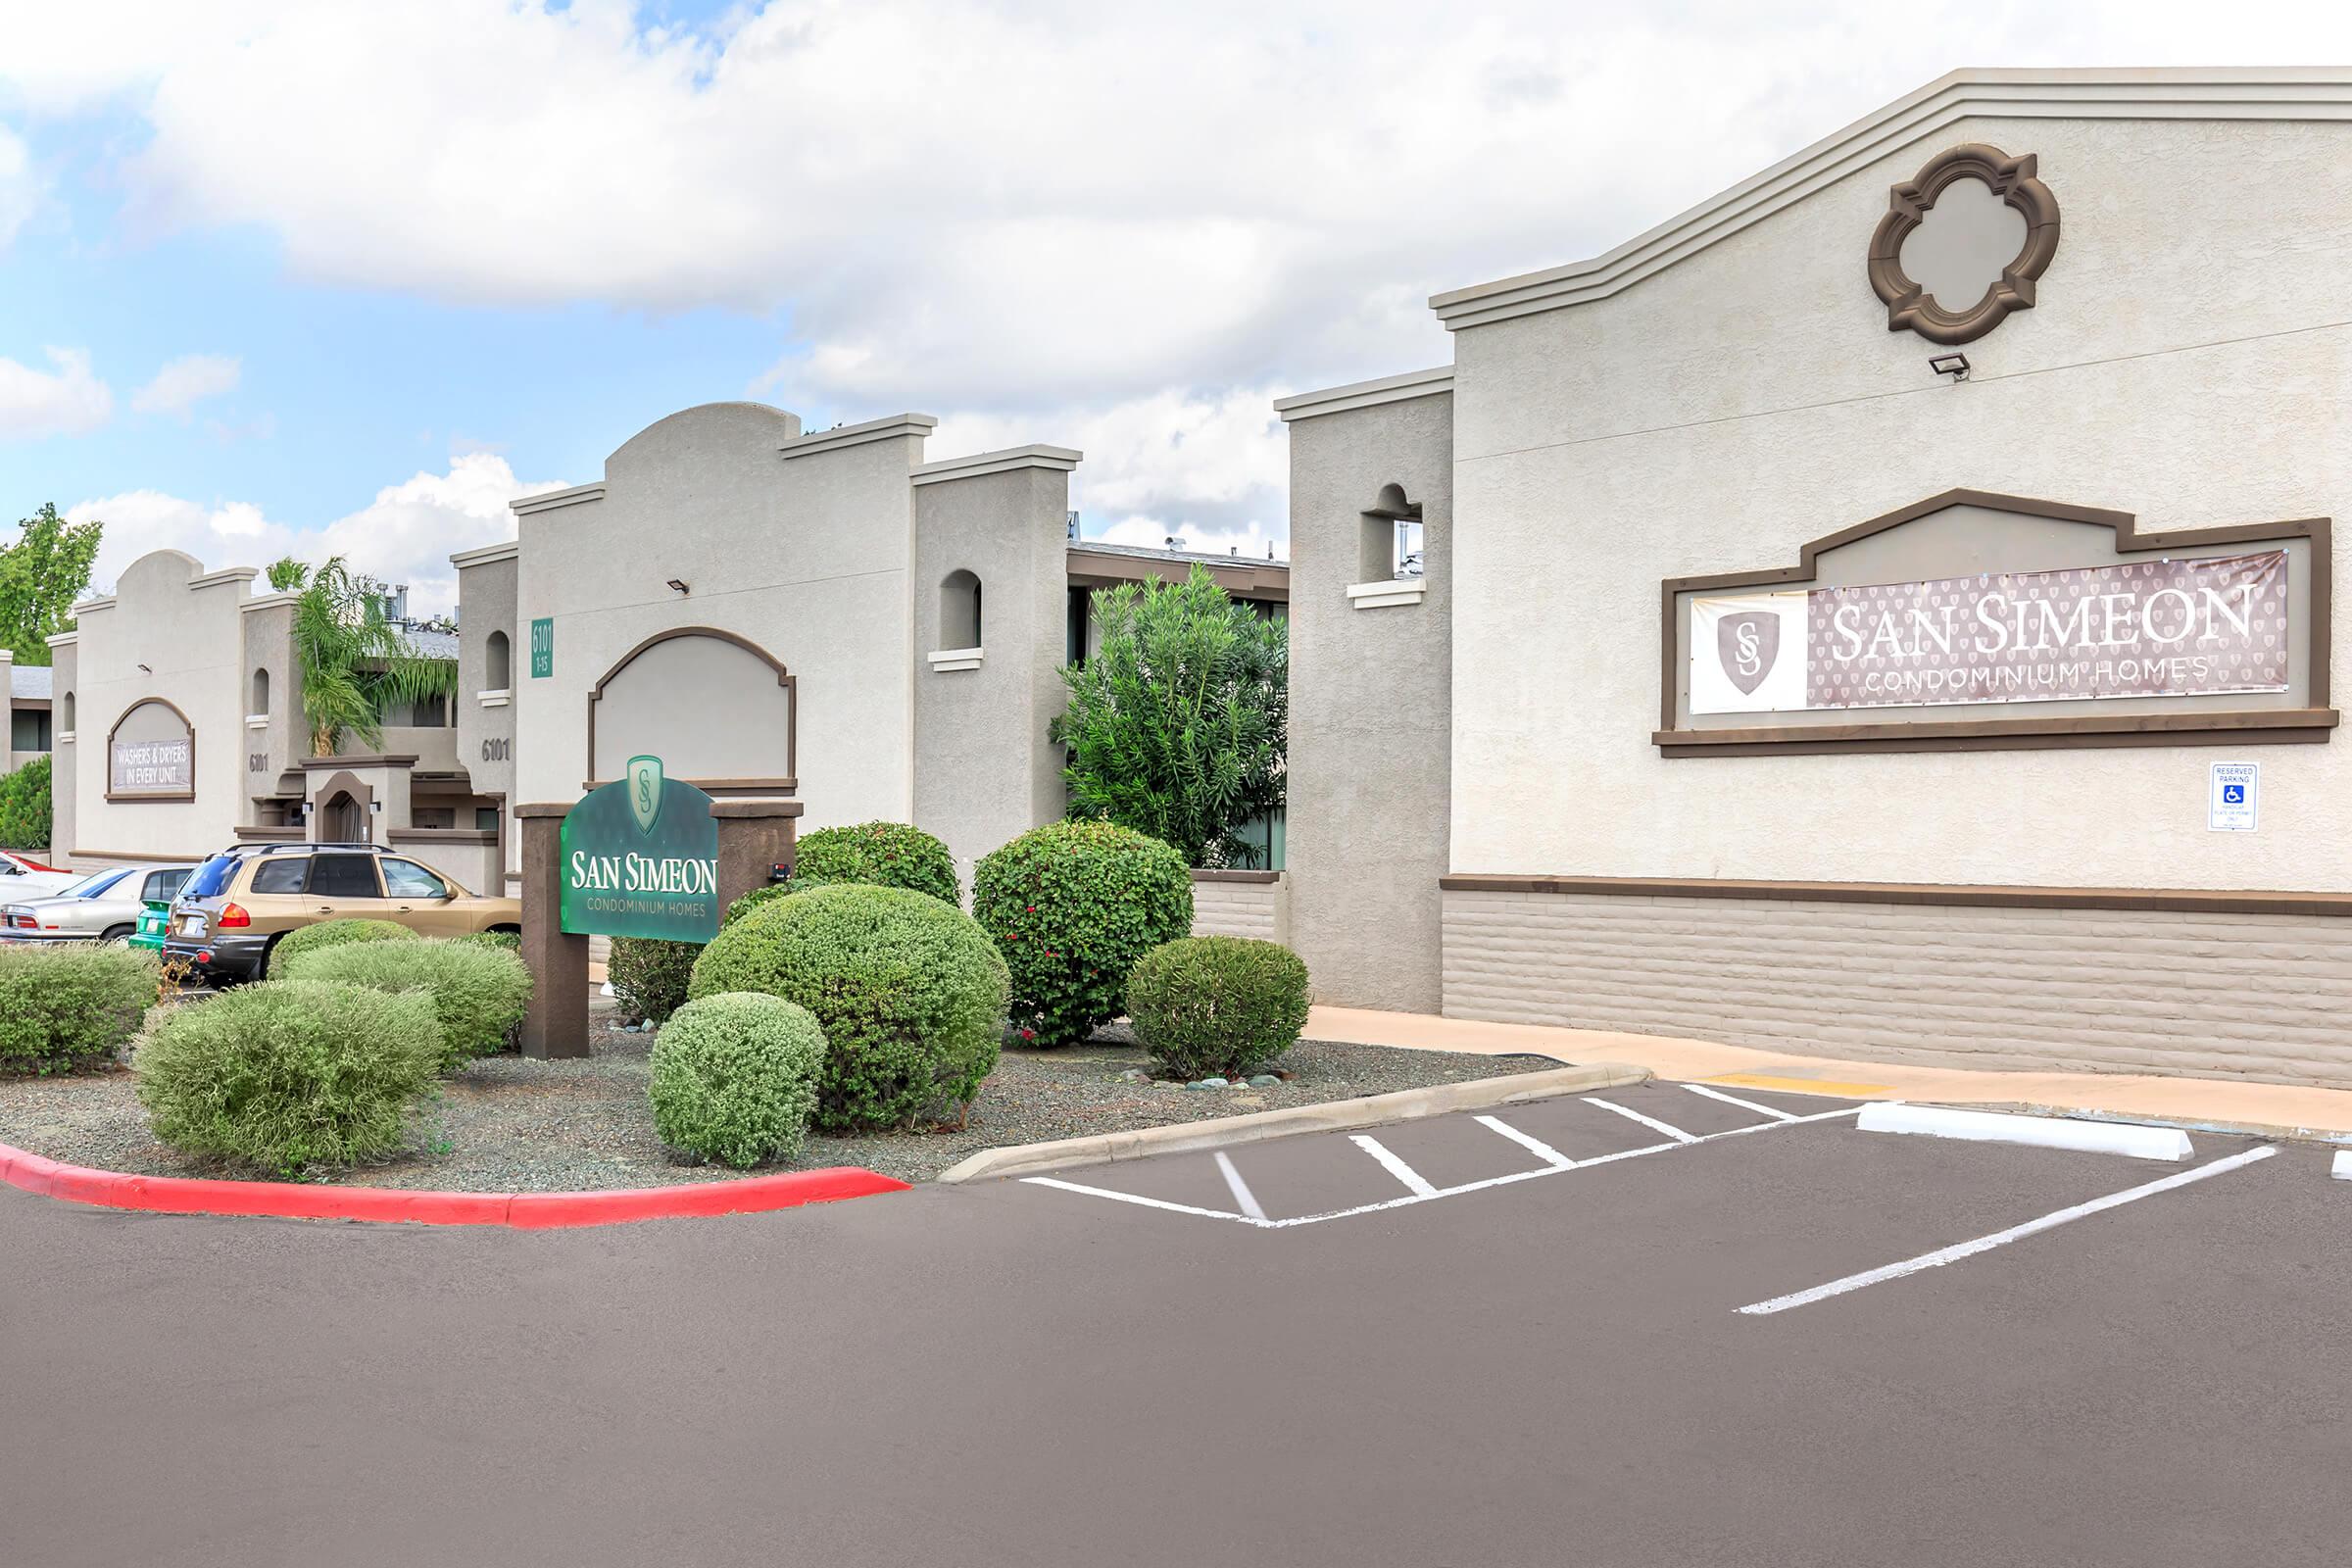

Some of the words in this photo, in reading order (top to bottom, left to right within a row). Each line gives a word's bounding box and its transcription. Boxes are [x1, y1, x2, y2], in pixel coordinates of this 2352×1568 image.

[1832, 605, 1957, 662] SAN
[1974, 583, 2258, 654] SIMEON
[532, 624, 552, 654] 6101
[536, 656, 548, 672] 1-15
[1865, 662, 2080, 692] CONDOMINIUM
[2095, 656, 2209, 681] HOMES
[118, 747, 151, 765] WASHERS
[152, 748, 159, 763] &
[160, 745, 187, 763] DRYERS
[481, 738, 511, 761] 6101
[249, 753, 269, 773] 6101
[126, 767, 134, 784] IN
[136, 766, 158, 784] EVERY
[159, 766, 177, 783] UNIT
[571, 850, 621, 891] SAN
[625, 852, 718, 895] SIMEON
[587, 897, 665, 914] CONDOMINIUM
[668, 901, 706, 918] HOMES
